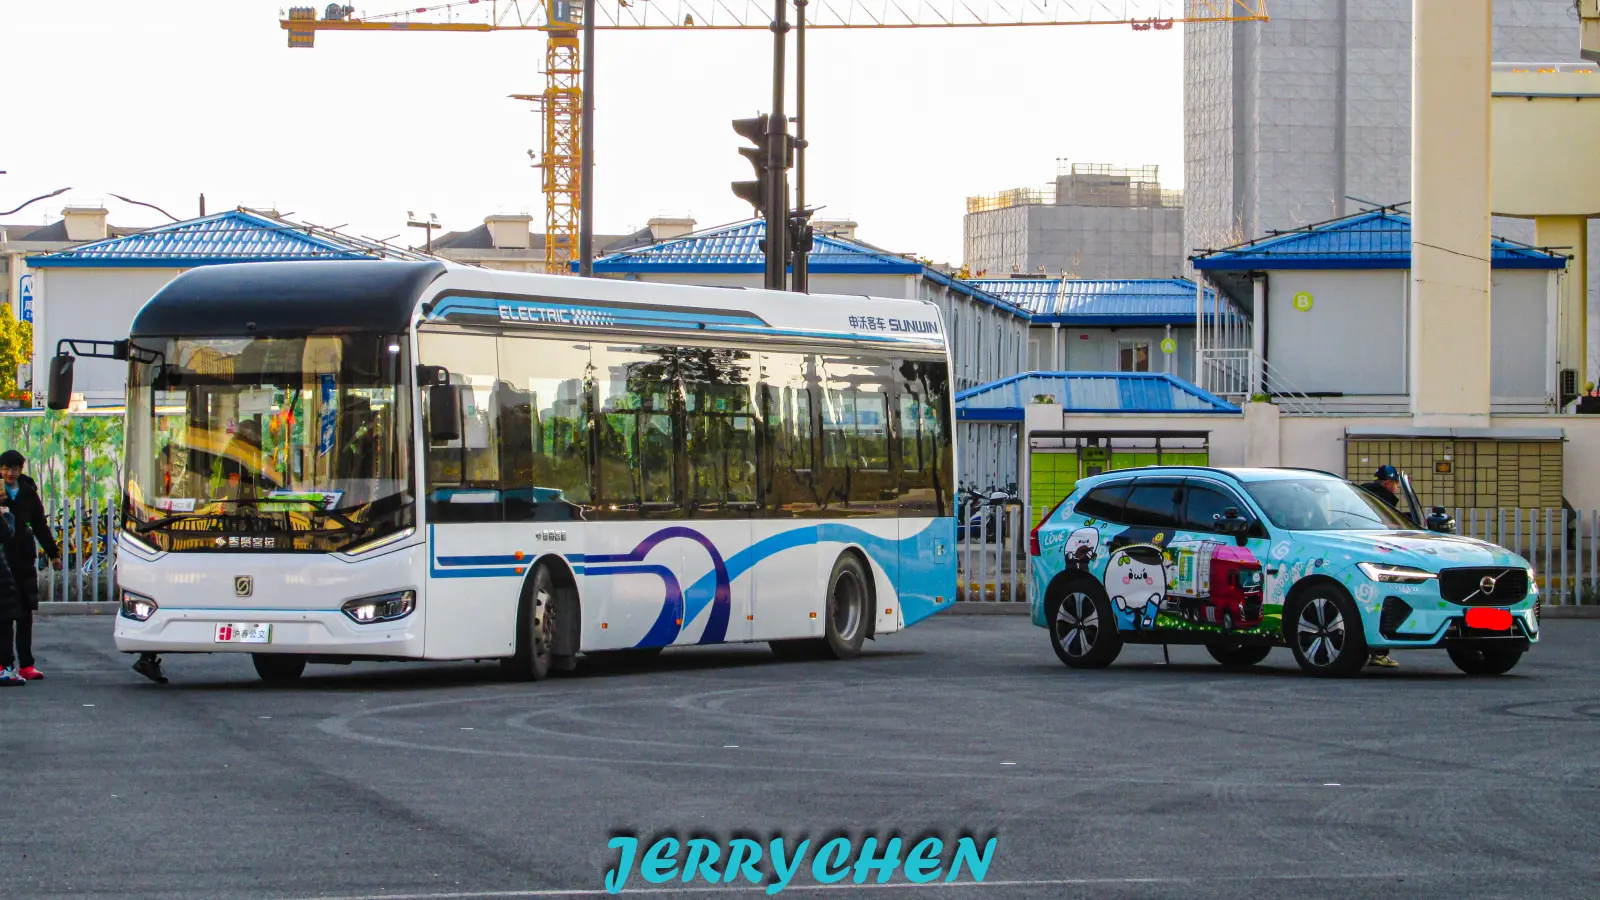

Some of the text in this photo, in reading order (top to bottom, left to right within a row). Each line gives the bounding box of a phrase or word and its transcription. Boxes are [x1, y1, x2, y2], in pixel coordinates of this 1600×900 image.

[1297, 294, 1309, 308] B
[499, 305, 570, 324] ELECTRIC
[848, 315, 938, 334] 申沃客车 SUNWIN
[1044, 530, 1065, 546] LOVE
